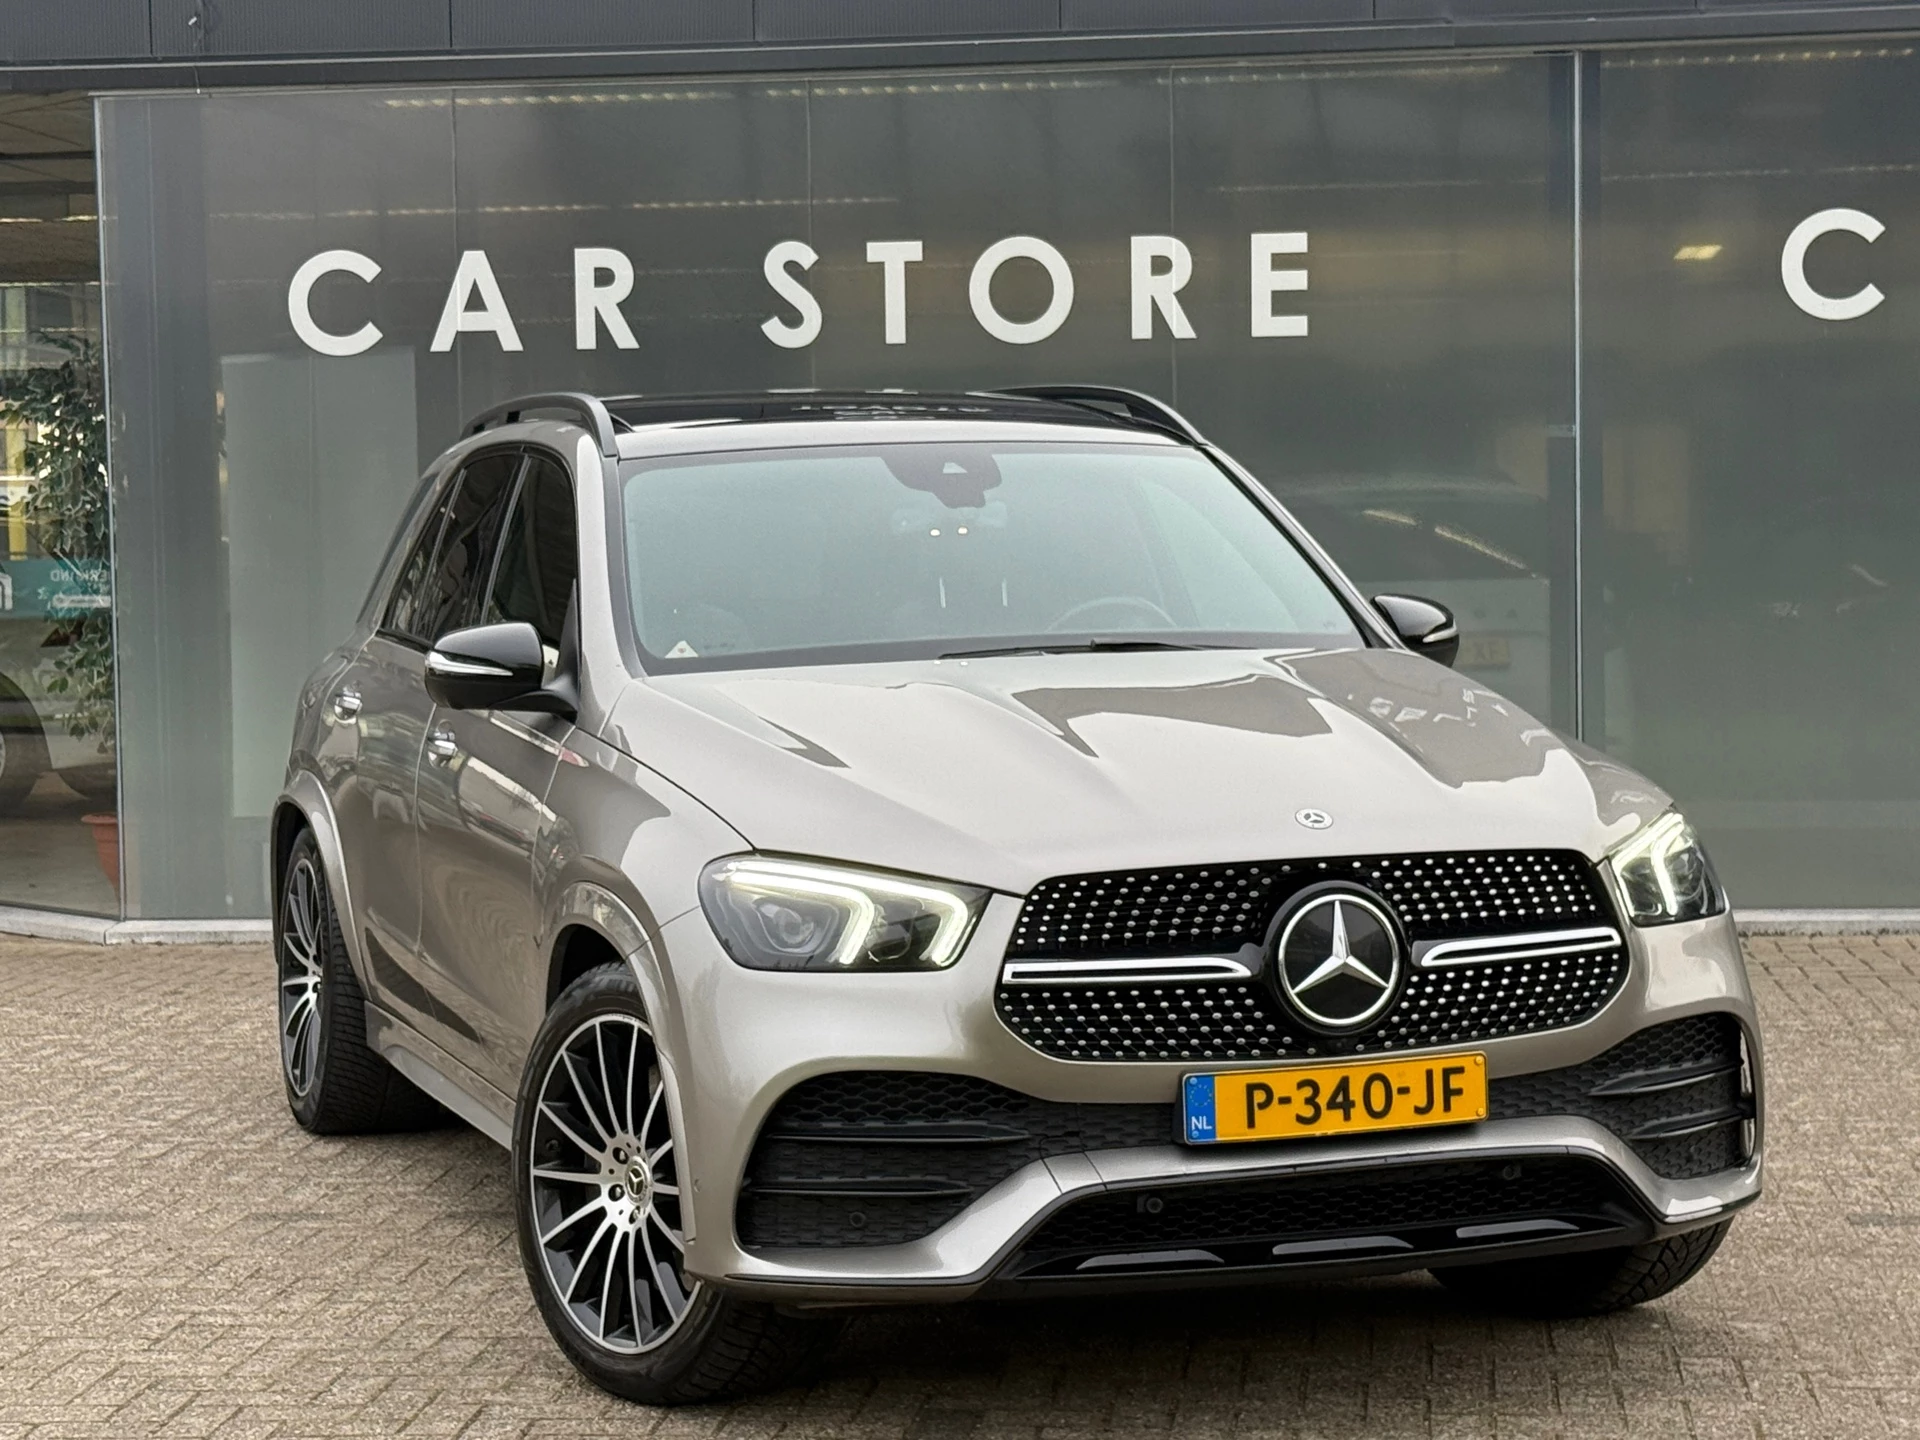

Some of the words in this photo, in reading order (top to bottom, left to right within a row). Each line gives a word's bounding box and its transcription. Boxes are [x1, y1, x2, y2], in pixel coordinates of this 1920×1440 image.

[287, 247, 640, 357] CAR
[760, 231, 1310, 350] STORE
[1780, 207, 1887, 321] C
[1191, 1115, 1213, 1131] NL
[1245, 1065, 1466, 1130] P-340-JF
